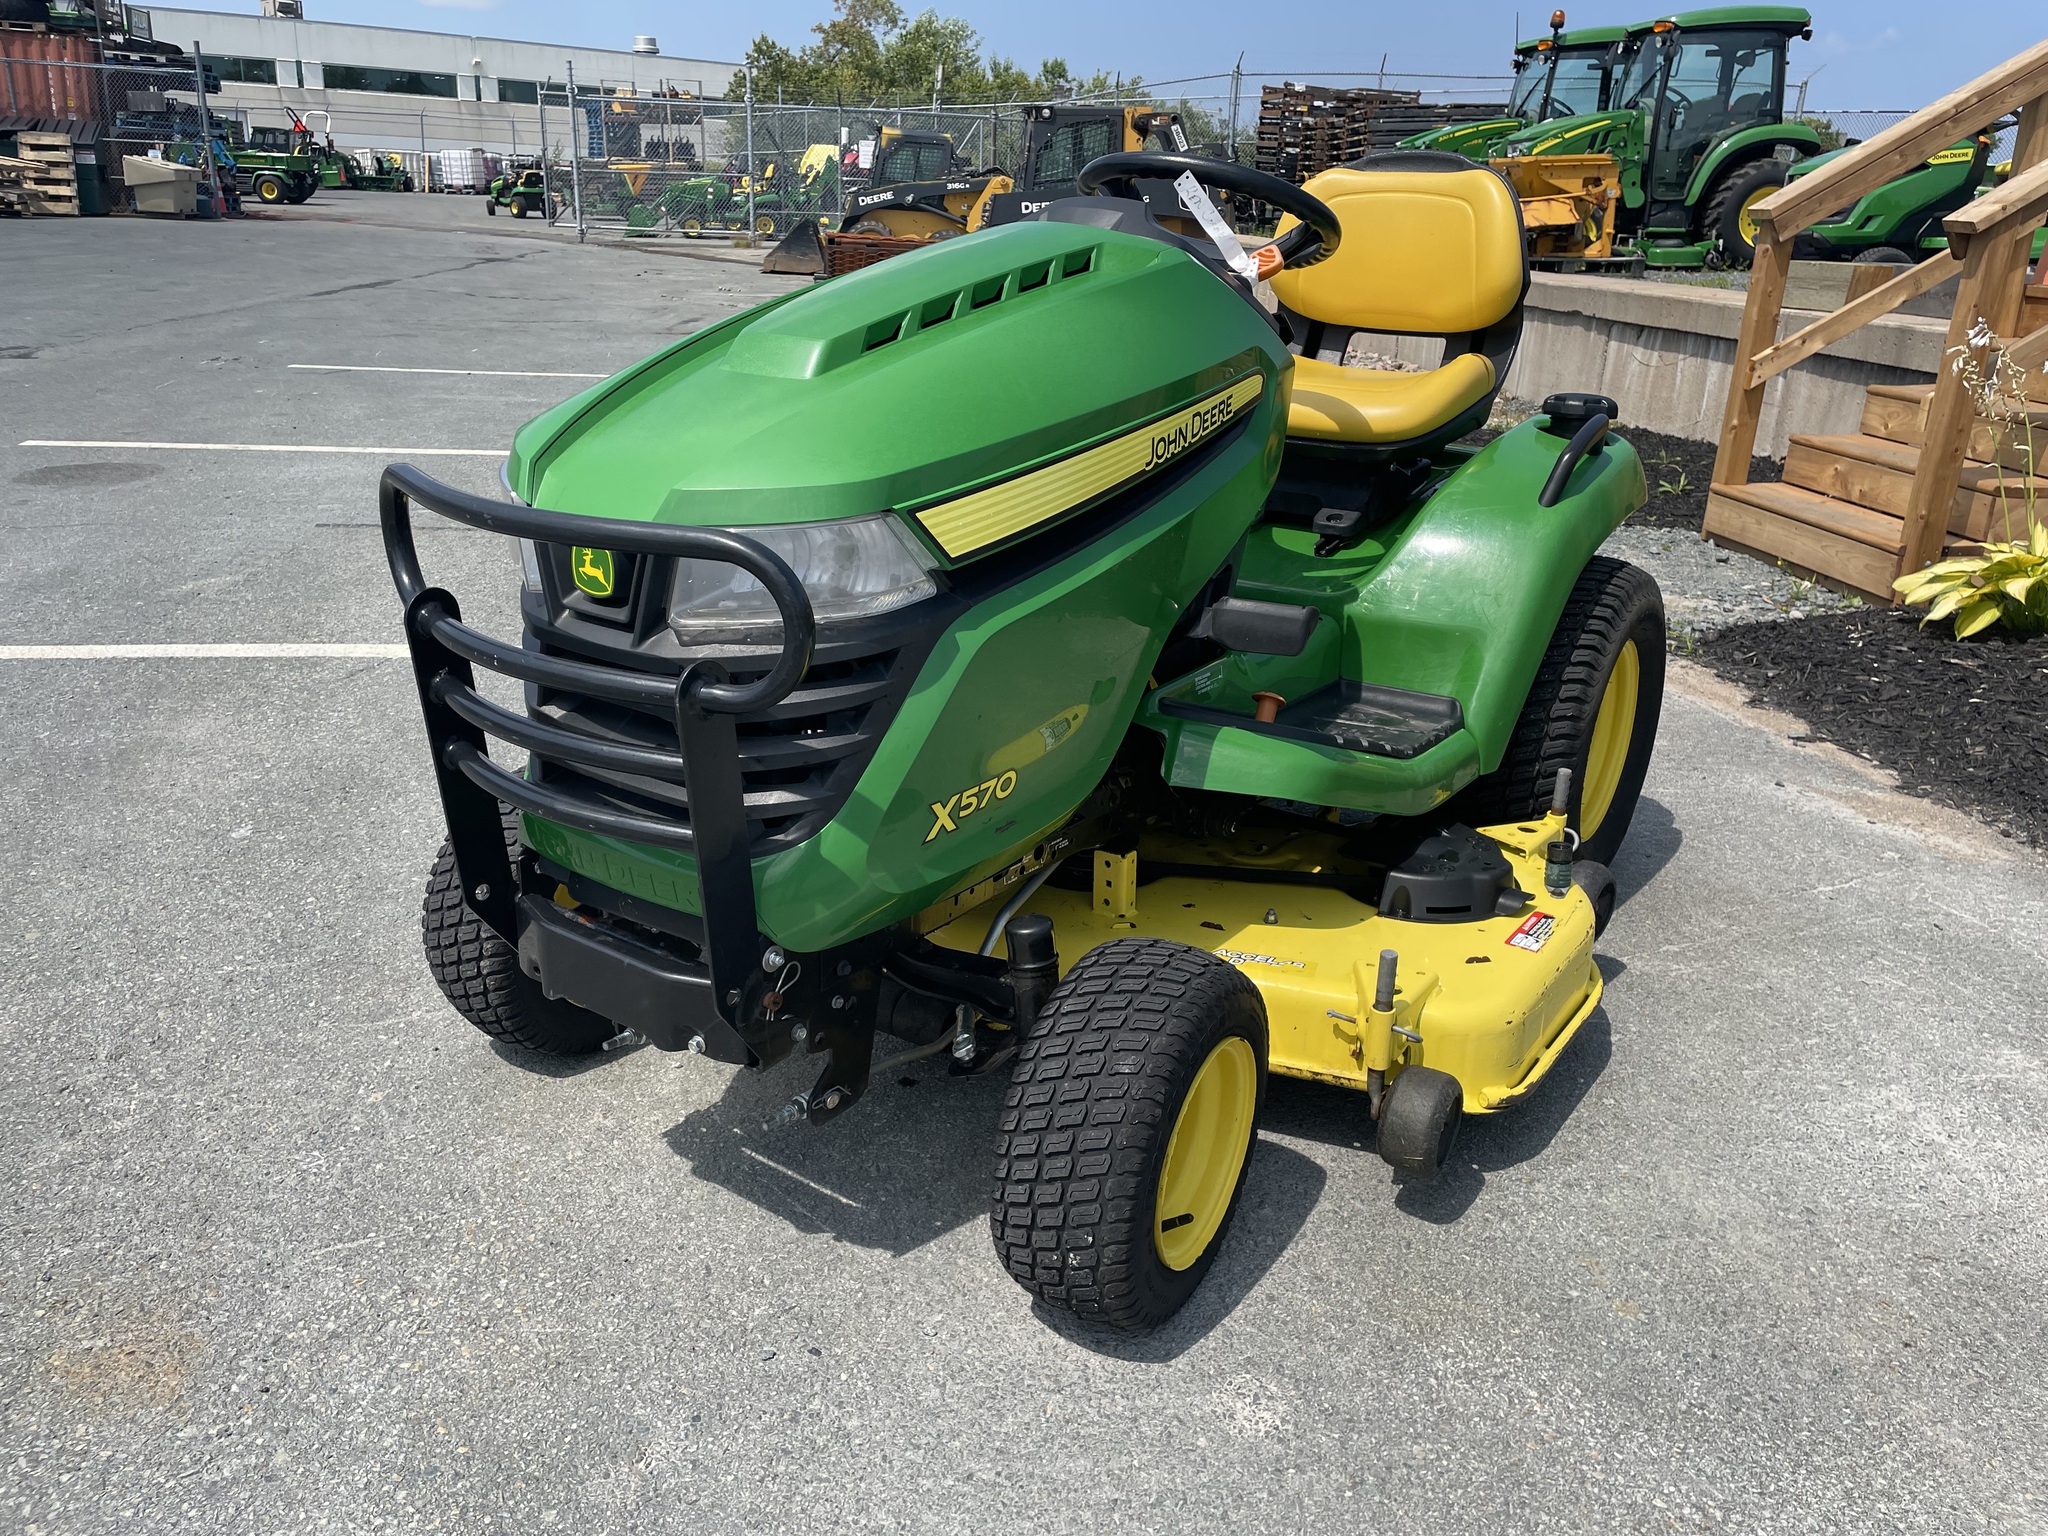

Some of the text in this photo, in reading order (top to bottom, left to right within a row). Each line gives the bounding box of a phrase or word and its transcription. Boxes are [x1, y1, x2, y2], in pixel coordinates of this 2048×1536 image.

[1931, 151, 1969, 161] JOHN DEERE
[858, 191, 895, 206] DEERE
[1144, 393, 1234, 470] JOHN DEERE
[921, 767, 1018, 846] X570
[603, 852, 703, 910] DEER
[1212, 949, 1276, 964] ACCEL
